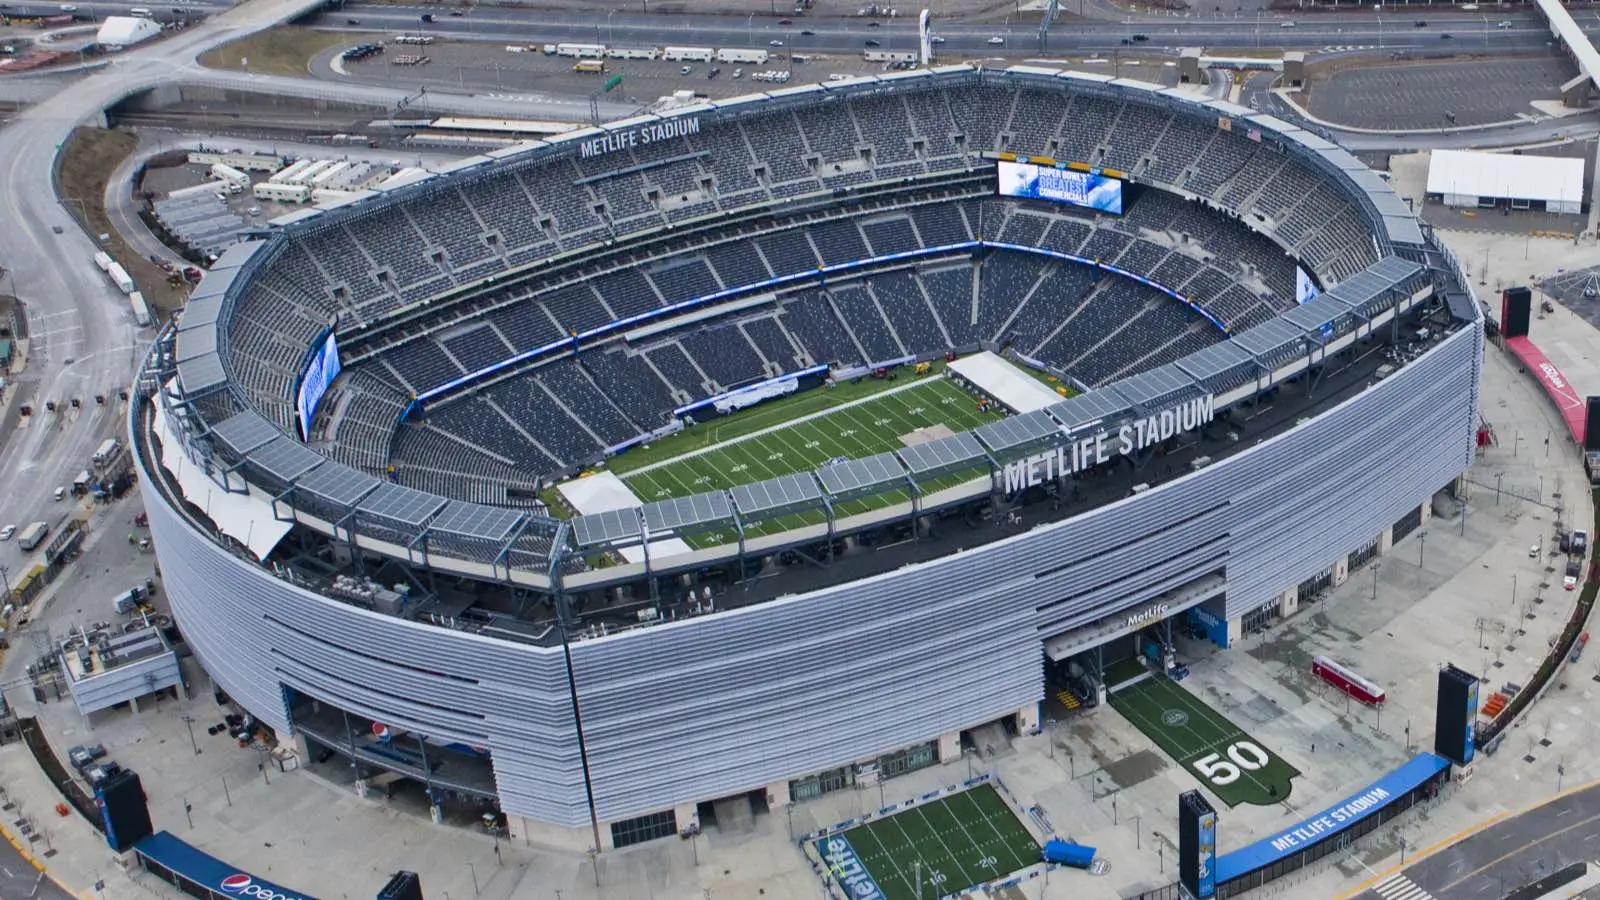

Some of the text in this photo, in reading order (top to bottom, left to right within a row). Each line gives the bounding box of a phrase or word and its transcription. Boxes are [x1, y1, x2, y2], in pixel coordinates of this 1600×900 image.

[580, 116, 700, 158] METLIFE STADIUM
[1038, 166, 1061, 179] SUPER
[1004, 394, 1215, 494] METLIFE STADIUM
[1127, 603, 1169, 626] MetLife
[1193, 741, 1269, 786] 50
[1271, 787, 1391, 852] METLIFE STADIUM
[826, 838, 882, 900] etLife
